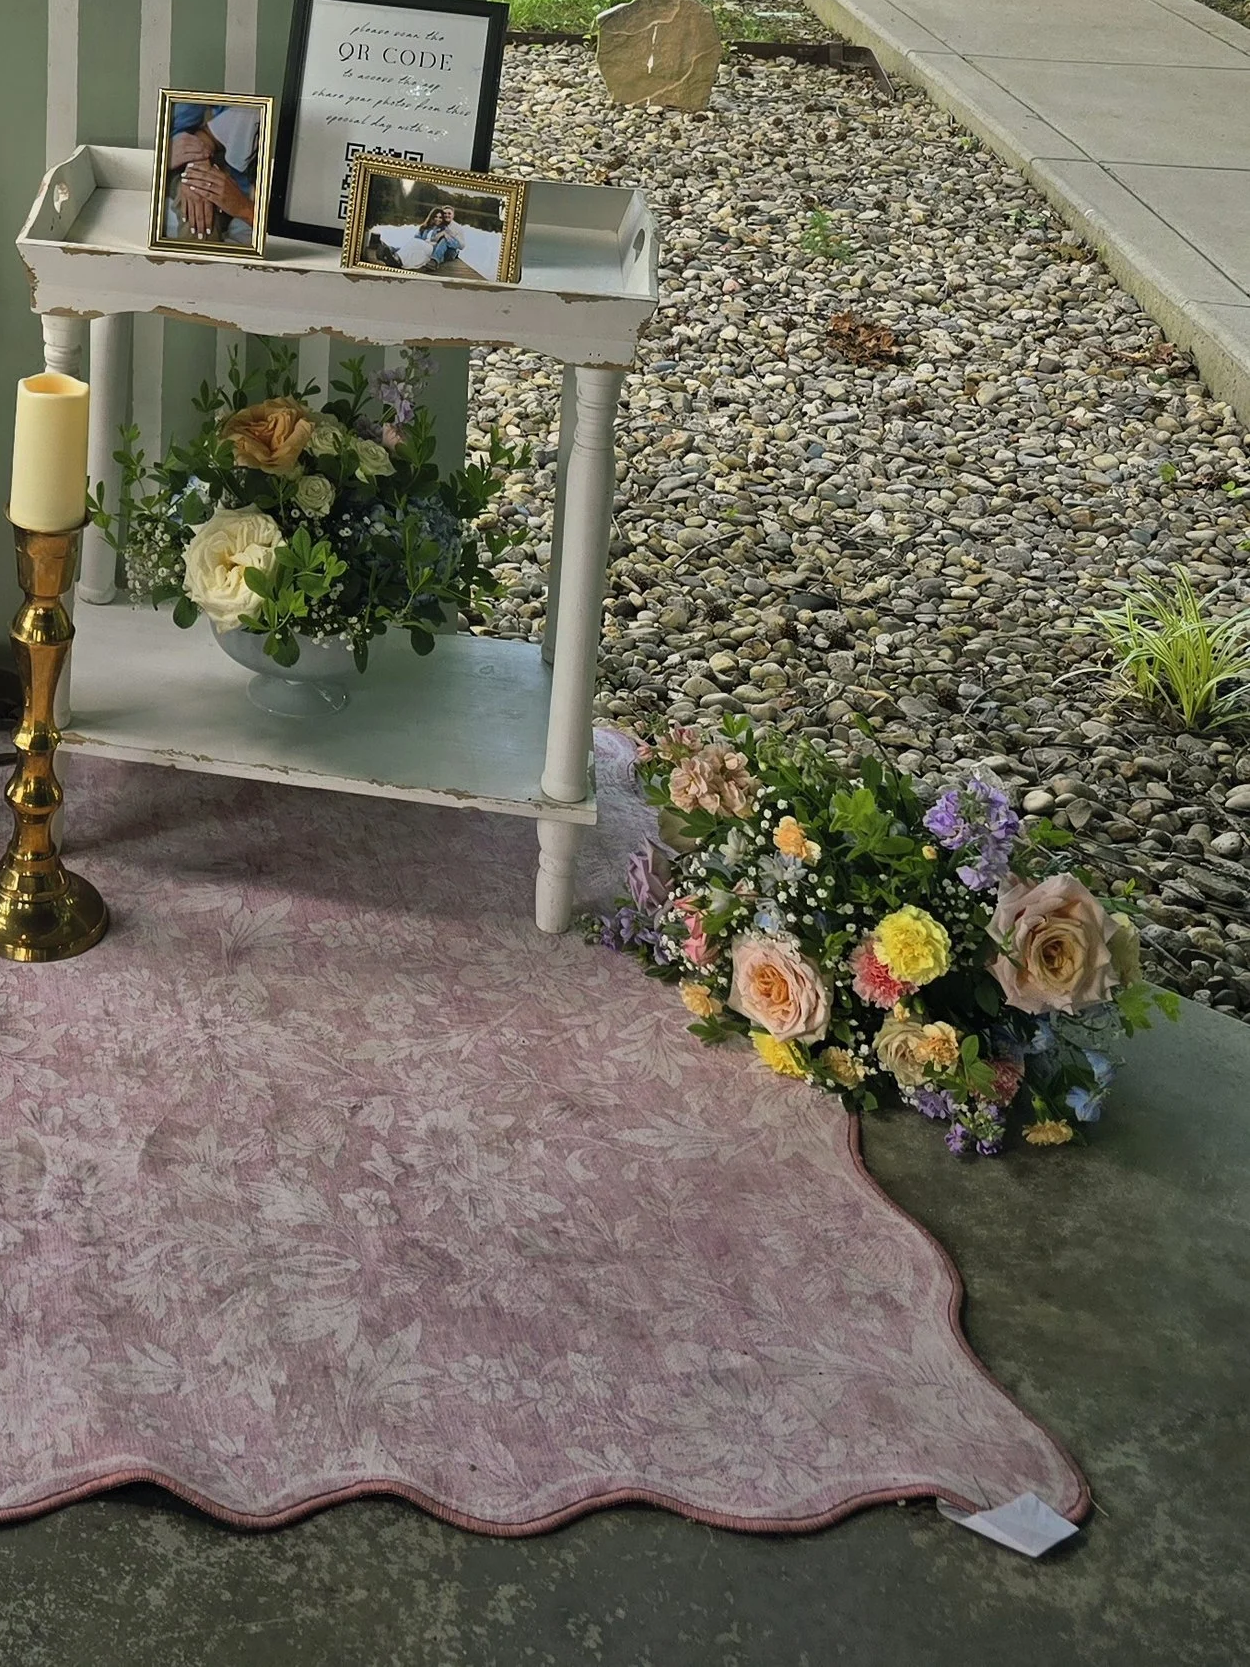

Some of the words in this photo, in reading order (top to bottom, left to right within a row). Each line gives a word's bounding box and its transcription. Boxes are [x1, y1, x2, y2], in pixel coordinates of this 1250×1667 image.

[349, 21, 390, 36] please
[393, 31, 420, 39] scan
[424, 30, 445, 42] the
[338, 41, 370, 62] QR
[382, 46, 453, 72] CODE
[342, 69, 353, 78] to
[357, 74, 395, 84] access
[398, 75, 417, 86] the
[311, 88, 345, 99] share
[345, 95, 372, 106] your
[371, 96, 411, 109] photos
[413, 98, 441, 111] from
[445, 103, 472, 117] this
[325, 115, 371, 126] special
[370, 115, 392, 134] day
[397, 122, 423, 133] with
